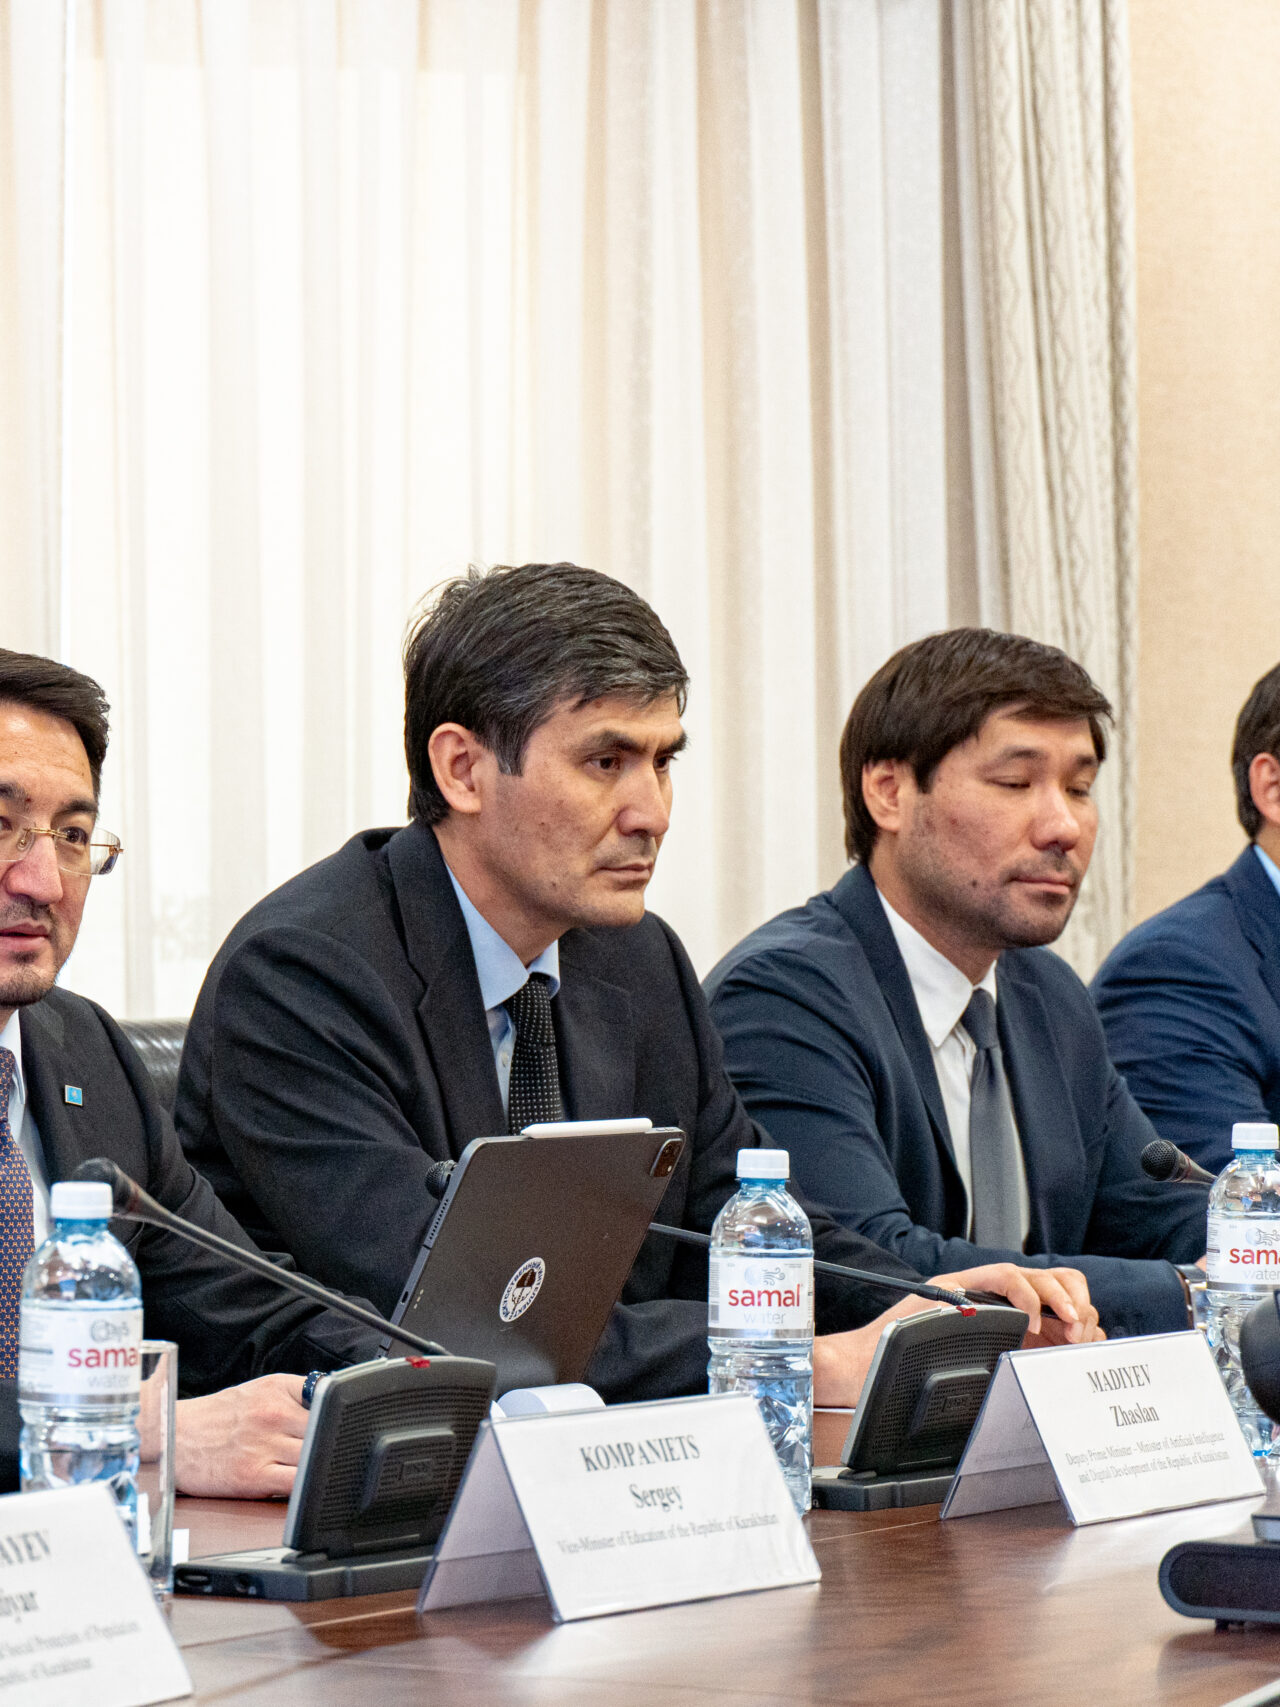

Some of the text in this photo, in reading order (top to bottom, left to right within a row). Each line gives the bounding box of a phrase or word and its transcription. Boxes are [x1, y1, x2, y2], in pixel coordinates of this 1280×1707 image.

[1229, 1248, 1280, 1265] sam
[728, 1283, 800, 1307] samal
[67, 1347, 138, 1368] sama
[1086, 1364, 1152, 1394] MADIYEV
[1109, 1403, 1160, 1428] Zhaslan
[579, 1434, 700, 1472] KOMPANIETS
[629, 1483, 684, 1514] Sergey
